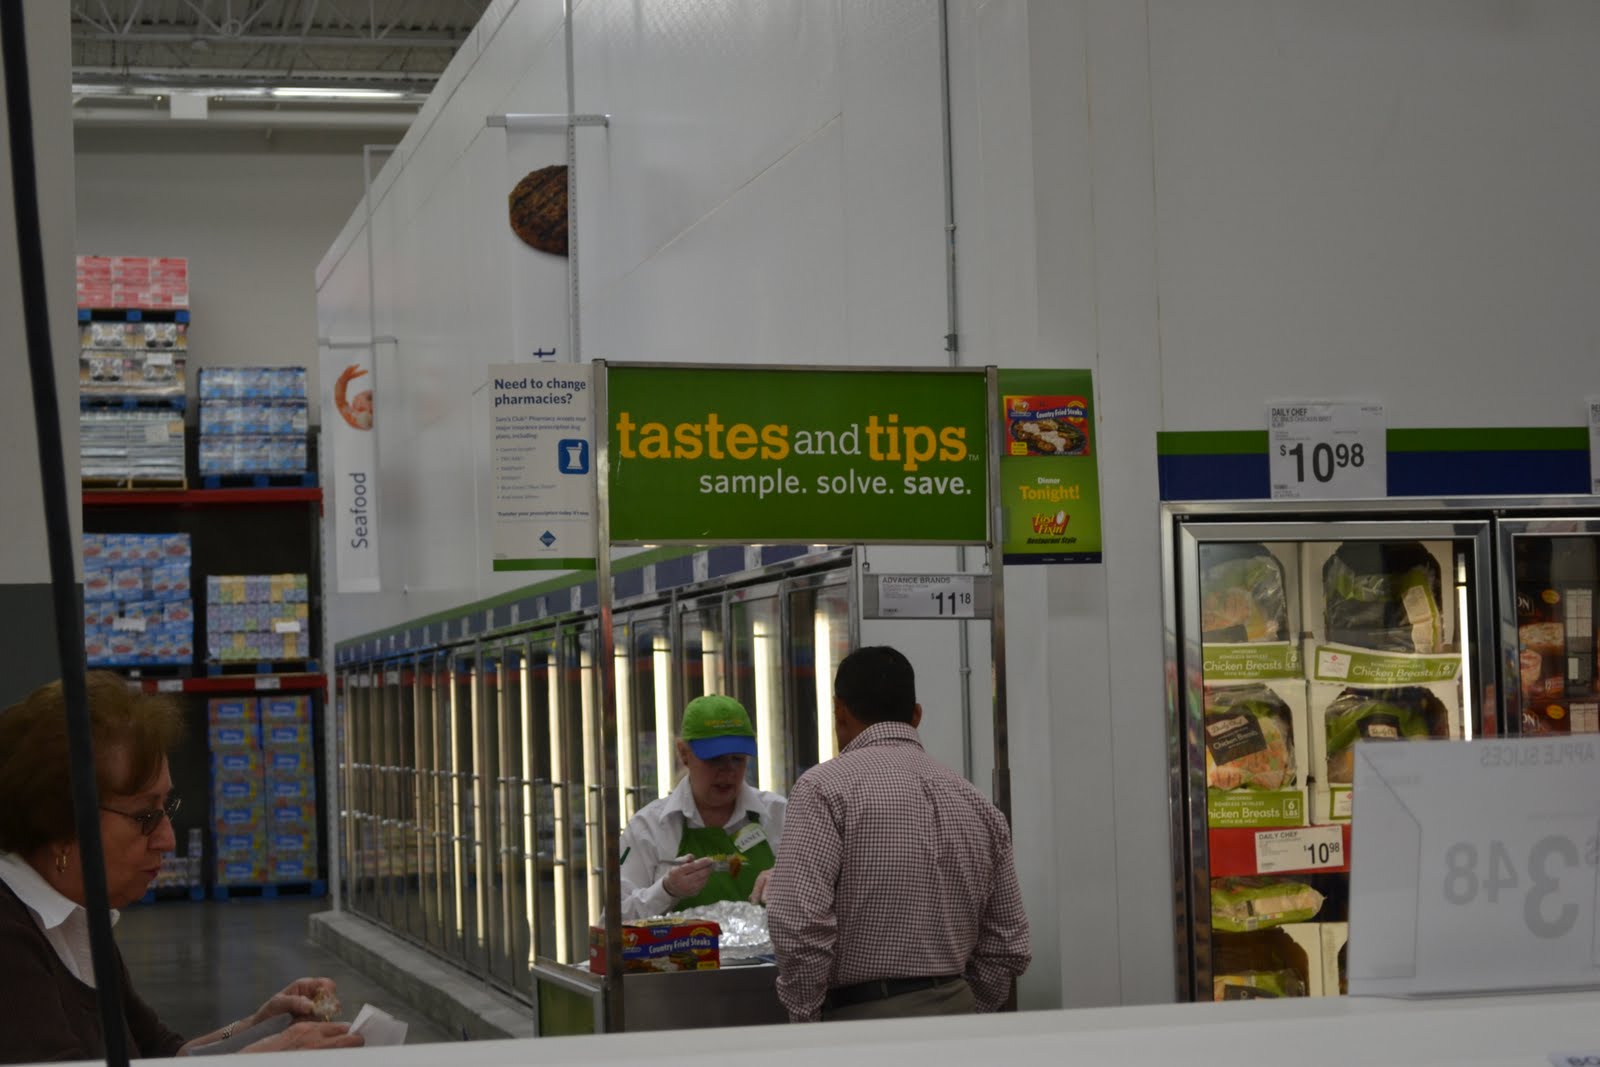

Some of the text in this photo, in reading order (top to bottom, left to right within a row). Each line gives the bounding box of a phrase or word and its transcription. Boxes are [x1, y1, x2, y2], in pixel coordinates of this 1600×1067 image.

[494, 377, 586, 392] Need to change
[494, 393, 573, 408] pharmacies?
[1036, 411, 1054, 419] Country
[1054, 409, 1067, 417] Fried
[1067, 408, 1083, 416] Steaks
[1271, 408, 1308, 417] DAILY CHEF
[615, 412, 790, 460] tastes
[793, 423, 862, 455] and
[865, 413, 968, 472] tips
[699, 467, 972, 500] sample. solve. save.
[1037, 477, 1061, 485] Dinner
[1019, 484, 1080, 503] Tonight!
[348, 472, 368, 549] Seafood
[1026, 536, 1077, 545] Restaurant Style
[882, 576, 918, 584] ADVANCE
[919, 576, 951, 584] BRANDS
[1203, 660, 1282, 672] Chicken Breasts
[1352, 664, 1434, 678] Chicken Breasts
[1213, 737, 1238, 750] Chicken
[1237, 730, 1258, 741] Breasts
[1288, 800, 1295, 809] 6
[1207, 807, 1280, 819] hicken Breasts
[1258, 831, 1298, 840] DAILY CHEF
[648, 937, 711, 955] Country Fried Steaks
